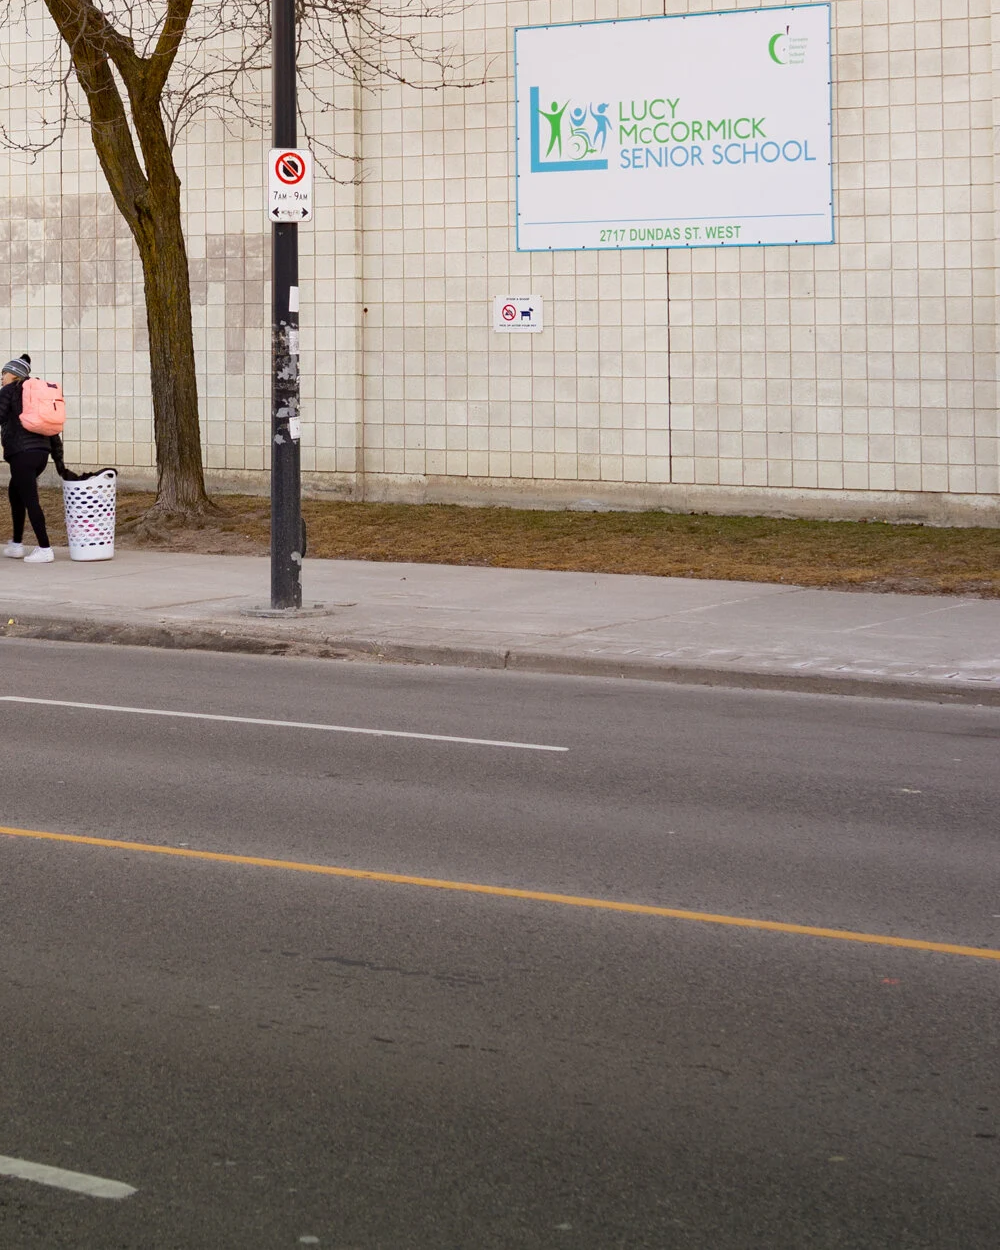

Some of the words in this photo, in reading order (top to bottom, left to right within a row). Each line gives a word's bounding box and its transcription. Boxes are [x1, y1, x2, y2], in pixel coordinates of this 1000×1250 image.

[619, 98, 680, 122] LUCY
[620, 145, 704, 169] SENIOR
[712, 140, 816, 165] SCHOOL
[273, 191, 287, 200] 7AM
[294, 191, 308, 201] 9AM
[600, 229, 626, 242] 2717
[629, 227, 680, 241] DUNDAS
[684, 227, 701, 240] ST.
[705, 225, 741, 239] WEST
